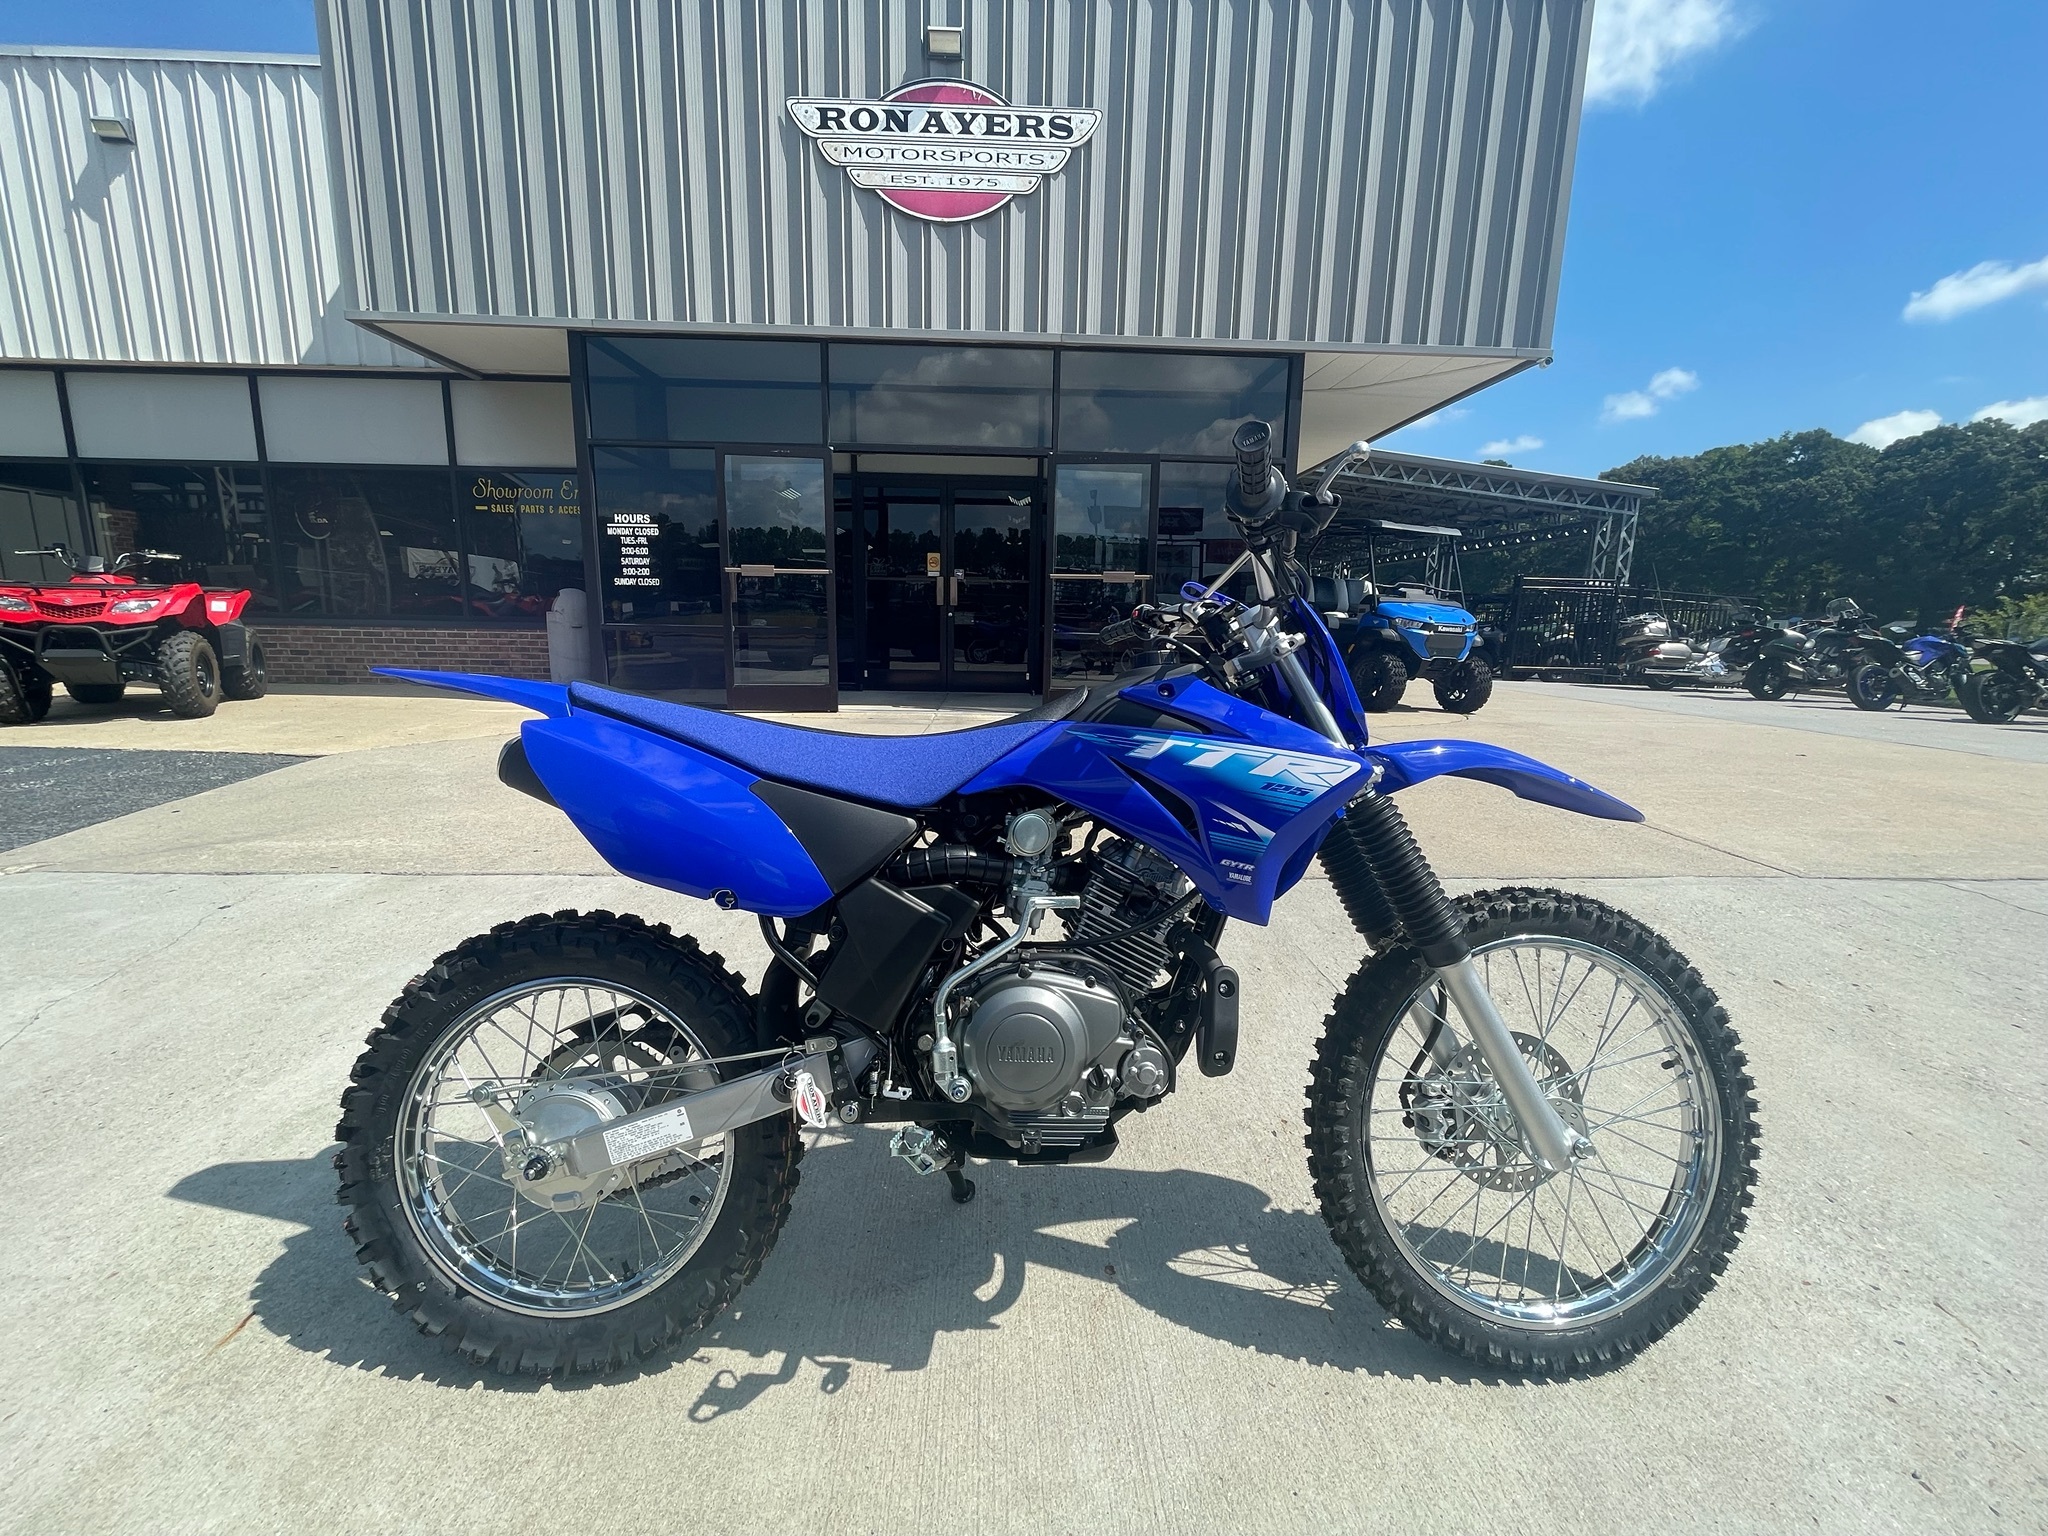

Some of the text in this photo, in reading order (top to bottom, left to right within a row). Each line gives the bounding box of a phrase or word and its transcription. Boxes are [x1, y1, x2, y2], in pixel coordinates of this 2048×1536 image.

[815, 106, 1075, 140] RON AYERS
[843, 146, 1045, 166] MOTORSPORTS
[890, 174, 998, 188] EST. 1975
[472, 477, 553, 500] Showroom
[520, 504, 545, 514] PARTS
[549, 505, 554, 514] &
[614, 513, 651, 524] HOURS
[607, 527, 660, 536] MONDAY CLOSED
[620, 557, 651, 566] SATURDAY
[613, 577, 660, 586] SUNDAY CLOSED
[1259, 781, 1314, 797] 125
[1220, 859, 1255, 871] GYTR
[996, 1045, 1054, 1063] YAMAHA
